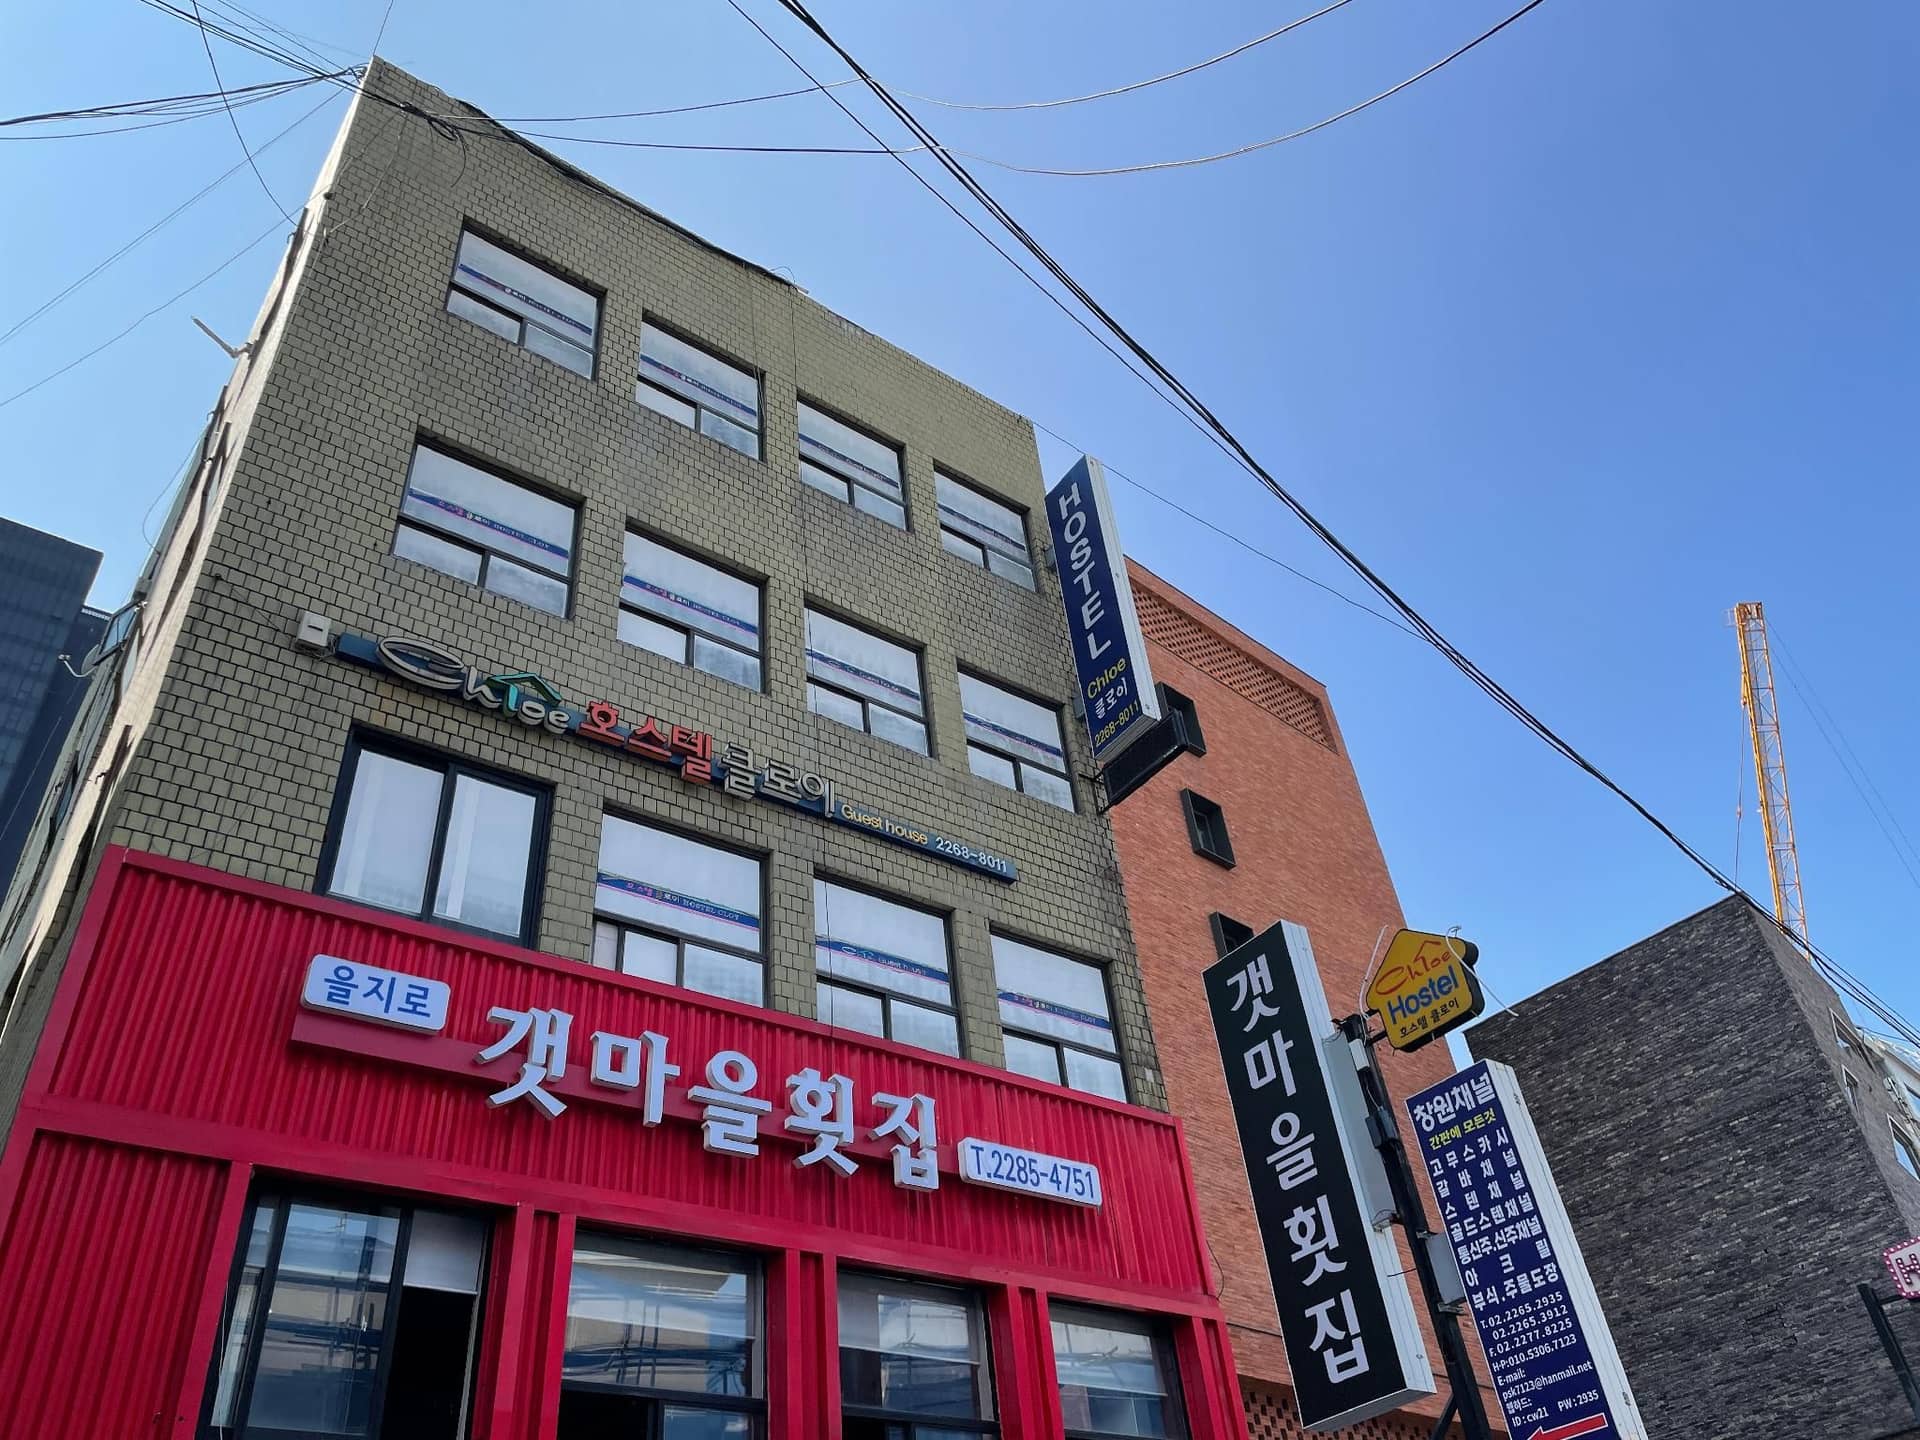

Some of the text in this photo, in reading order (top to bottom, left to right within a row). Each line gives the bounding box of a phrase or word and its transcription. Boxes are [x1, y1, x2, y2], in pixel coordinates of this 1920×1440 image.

[1058, 482, 1112, 660] HOSTEL
[1087, 657, 1127, 699] Chloe
[1095, 677, 1128, 719] 클로이
[1094, 699, 1140, 747] 2268-8011
[576, 699, 713, 784] 호스텔
[718, 741, 836, 818] 클로이
[935, 837, 1008, 873] 2268-8011
[323, 964, 432, 1018] 을지로
[1376, 942, 1452, 995] Chloe
[1387, 964, 1460, 1025] Hostel
[1400, 997, 1459, 1039] 호스텔 클로이
[473, 1006, 939, 1191] 갯마을횟집
[1413, 1071, 1496, 1132] 창원채널
[1429, 1107, 1497, 1151] 간판에 모든것
[970, 1144, 1094, 1200] T.2285-4751
[1227, 953, 1370, 1384] 갯마을횟집
[1492, 1304, 1569, 1340] 02.2265.3912
[1502, 1360, 1593, 1402] psk7123@hanmail.net
